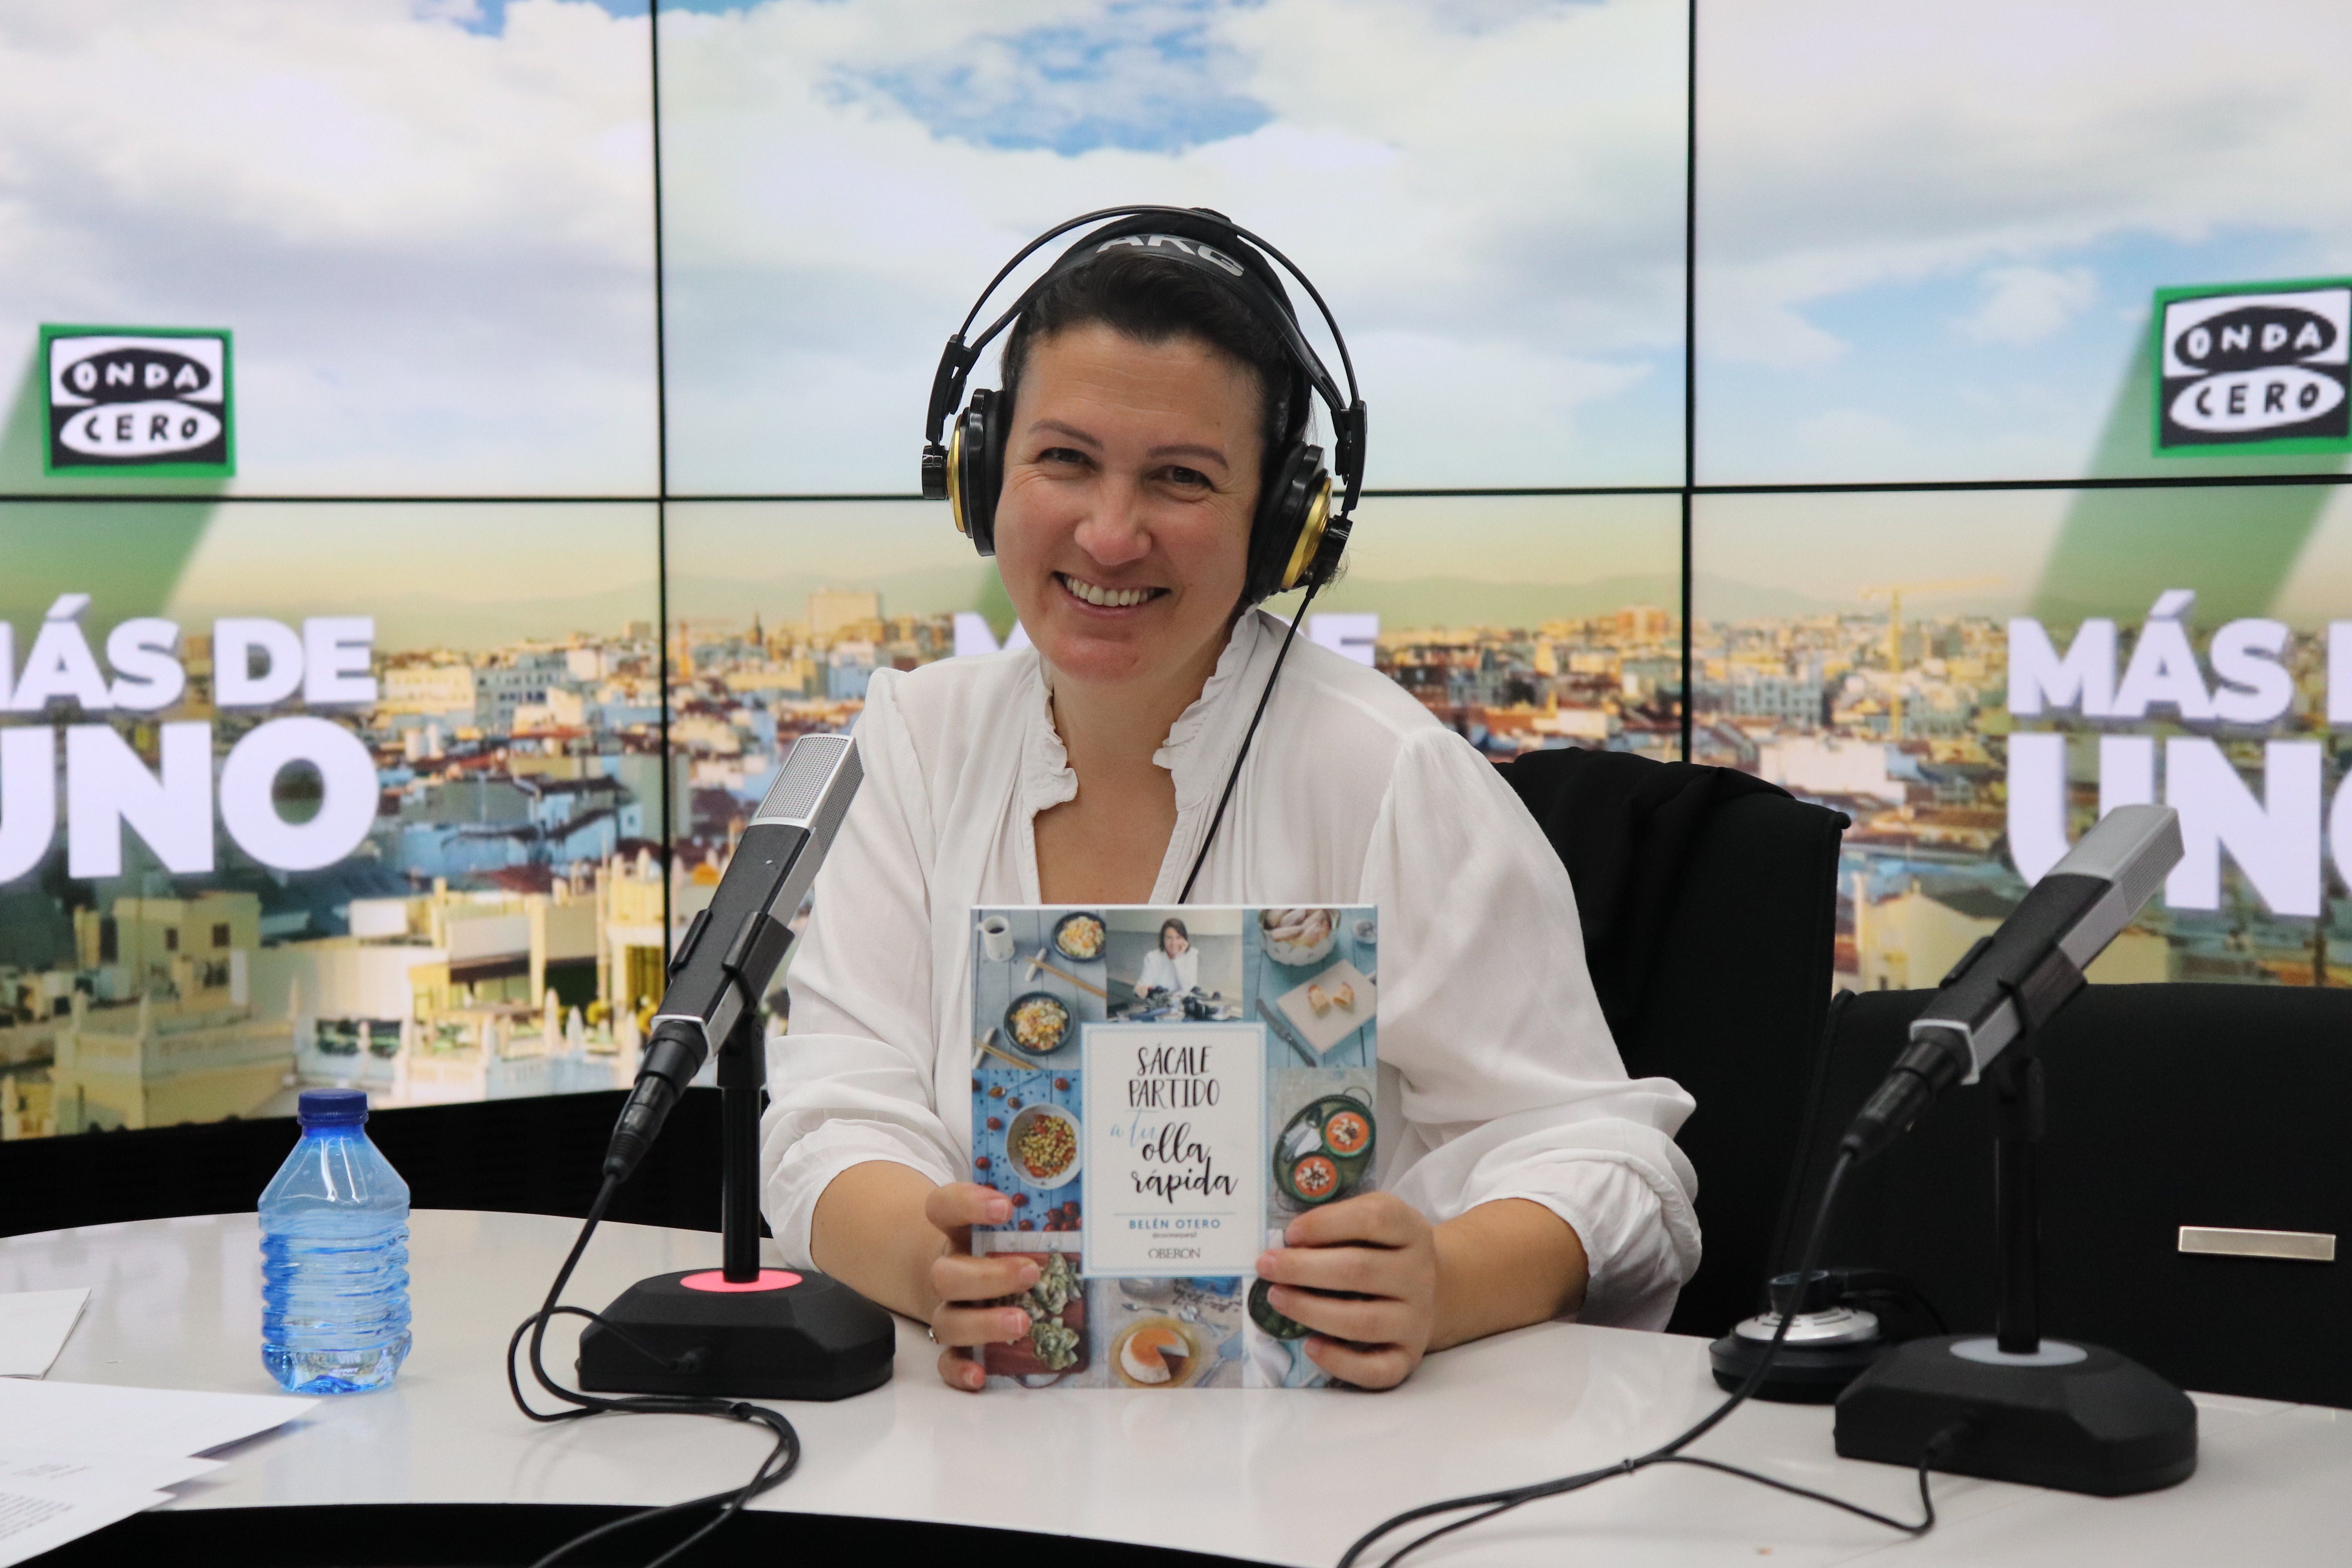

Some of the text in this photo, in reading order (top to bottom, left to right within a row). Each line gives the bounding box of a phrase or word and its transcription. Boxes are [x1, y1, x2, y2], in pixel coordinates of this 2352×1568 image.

[1096, 235, 1244, 276] AKG
[2187, 320, 2322, 360] ONDA
[73, 361, 200, 392] ONDA
[2195, 382, 2320, 417] CERO
[84, 414, 199, 442] CERO
[0, 593, 378, 710] ÁS DE
[2007, 588, 2294, 724] MÁS
[2007, 732, 2352, 918] UN
[1137, 1042, 1213, 1076] SÁCALE
[1128, 1079, 1220, 1109] PARTIDO
[1142, 1122, 1212, 1164] olla
[1131, 1156, 1239, 1204] rápida
[1129, 1218, 1221, 1229] BELÉN OTERO
[1148, 1248, 1201, 1259] OBERON
